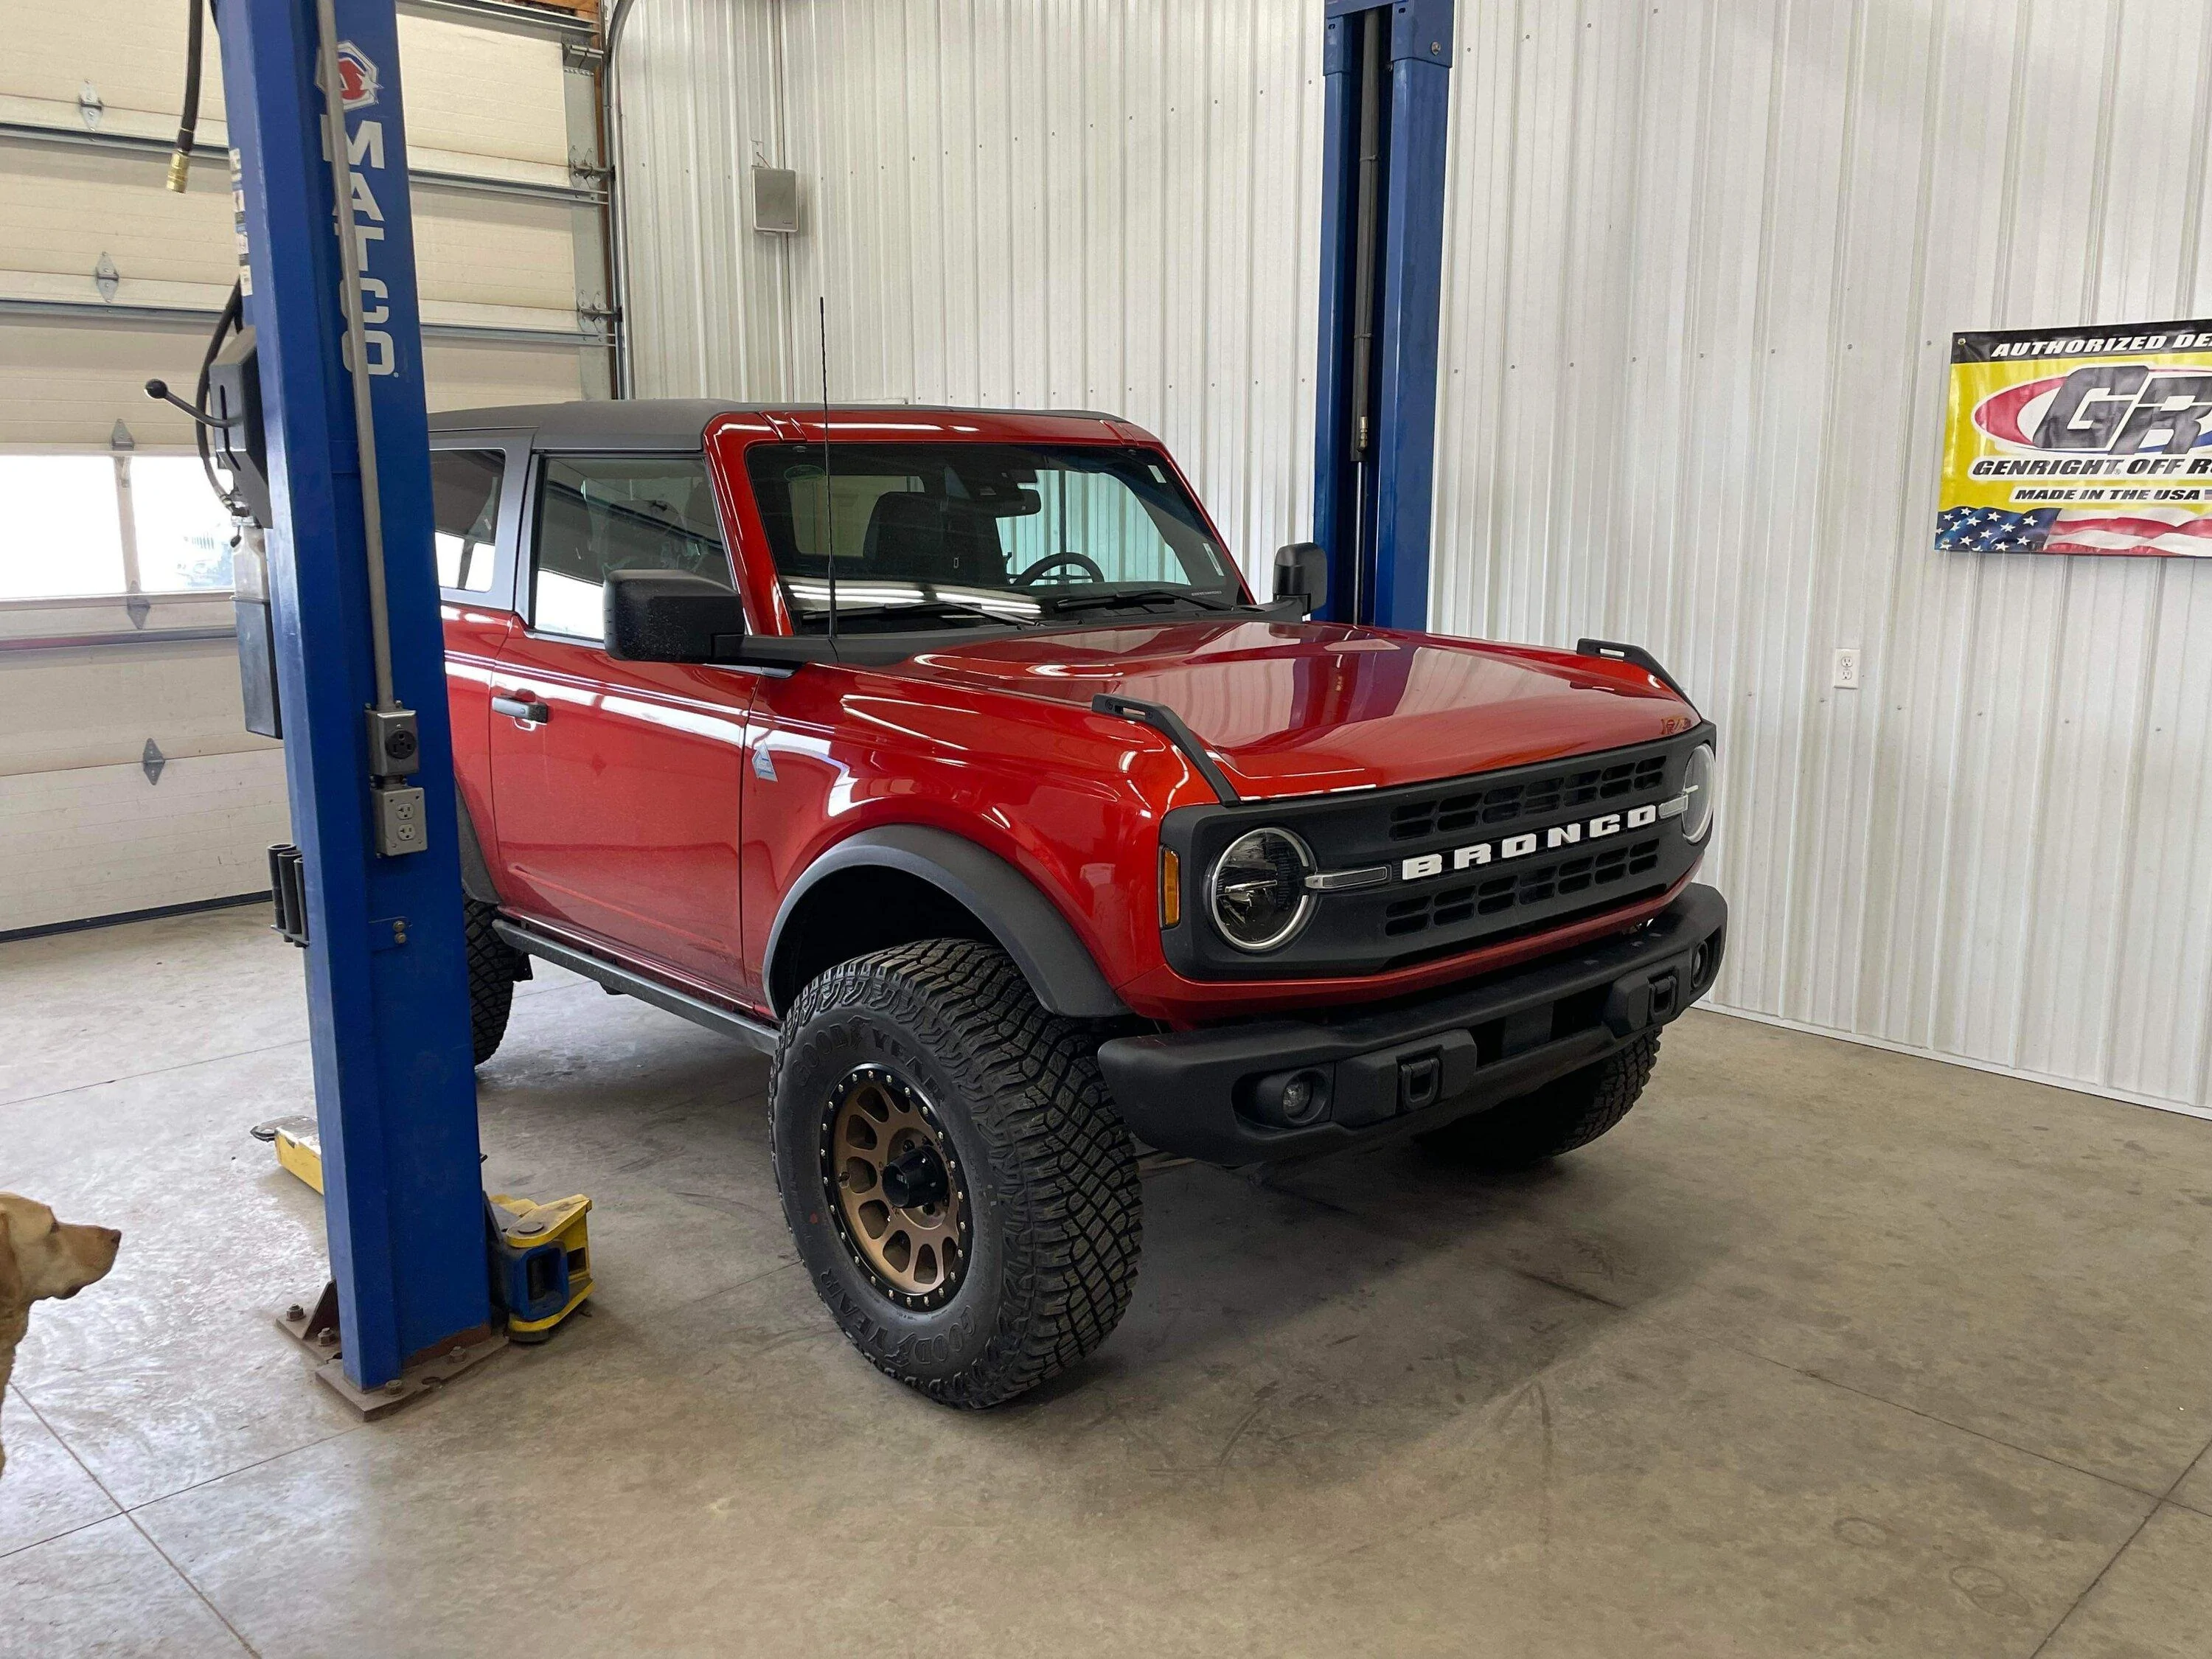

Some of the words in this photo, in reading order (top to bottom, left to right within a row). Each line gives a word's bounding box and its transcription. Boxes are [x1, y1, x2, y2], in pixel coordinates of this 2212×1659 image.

[1991, 335, 2167, 357] AUTHORIZED
[2171, 333, 2212, 349] DE
[2126, 459, 2185, 474] OFF
[2186, 459, 2212, 474] R
[2014, 489, 2076, 500] MADE
[2079, 490, 2104, 500] IN
[2110, 489, 2153, 500] THE
[2154, 489, 2200, 500] USA
[1402, 804, 1656, 880] BRONCO
